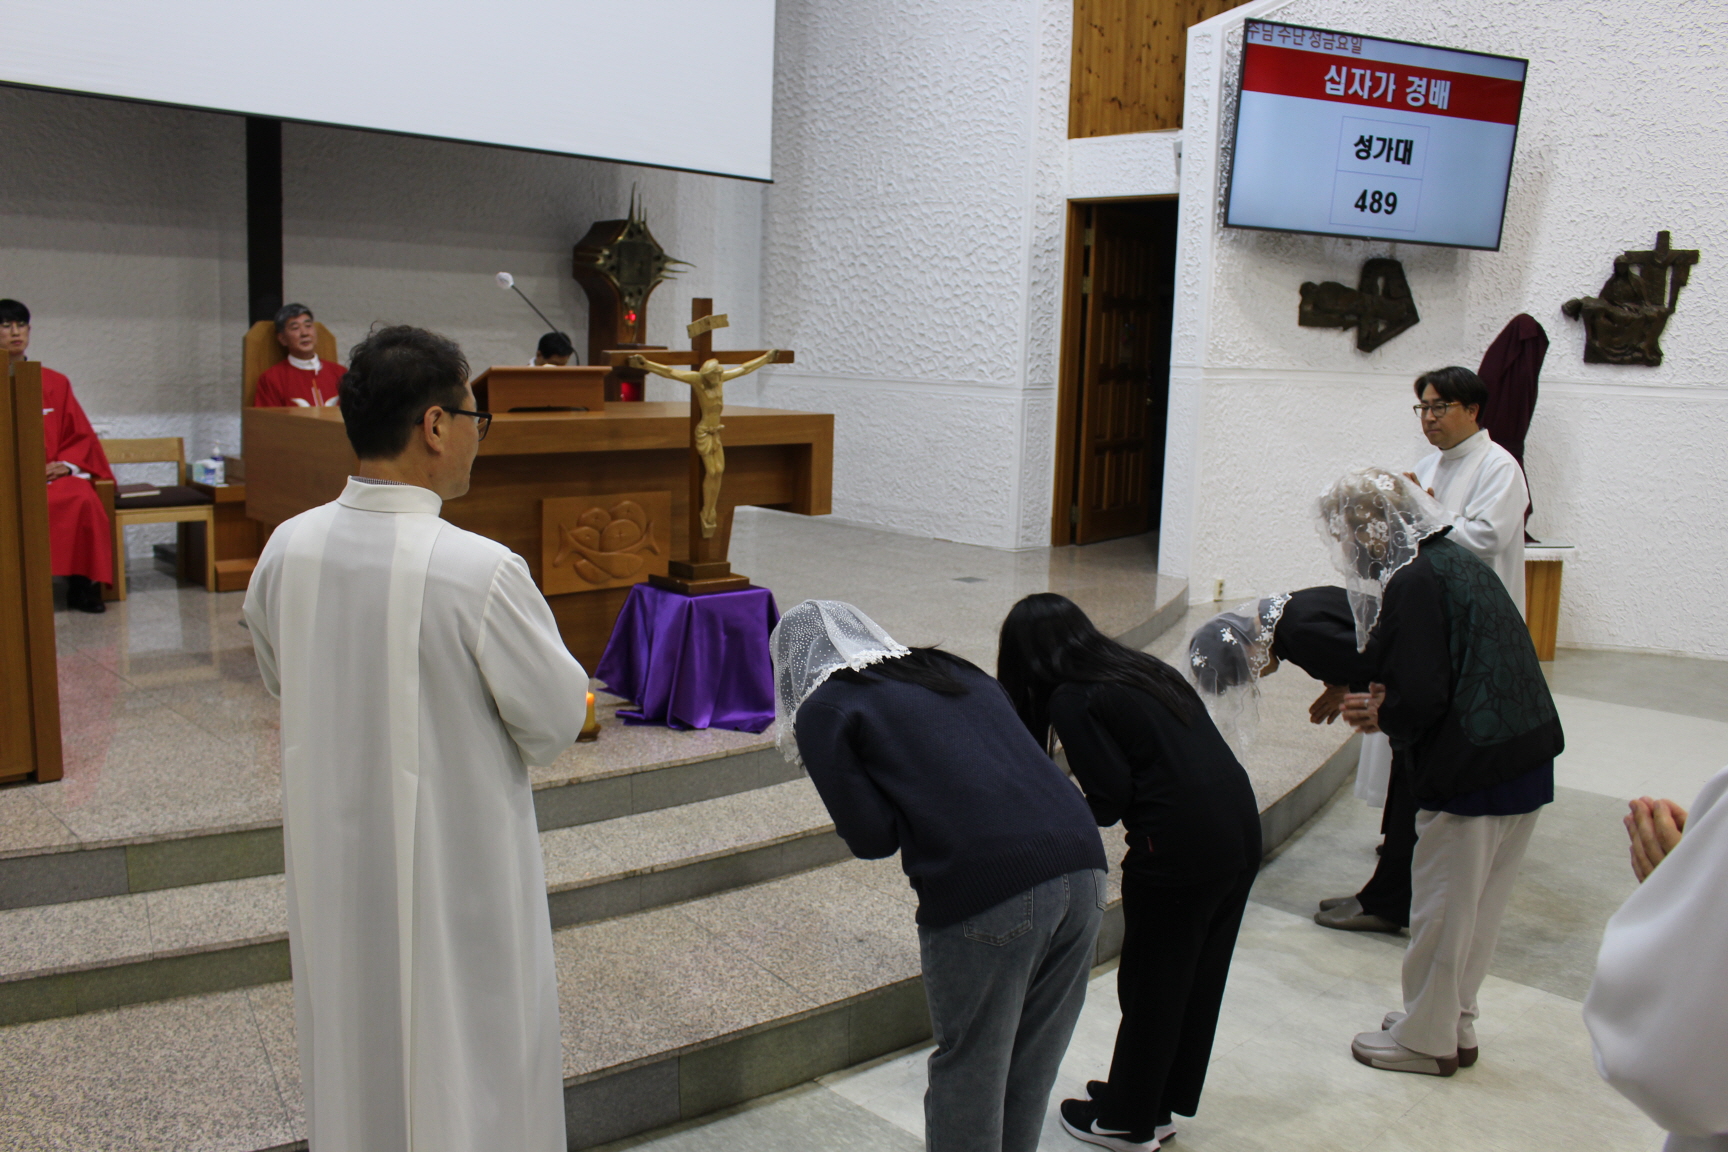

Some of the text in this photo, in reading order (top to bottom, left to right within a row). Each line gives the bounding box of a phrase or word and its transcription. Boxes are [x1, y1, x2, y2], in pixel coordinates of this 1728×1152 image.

[1247, 22, 1363, 54] 주님 수난 성금요일
[1324, 65, 1451, 110] 십자가 경배
[1353, 135, 1414, 165] 성가대
[1354, 189, 1398, 215] 489
